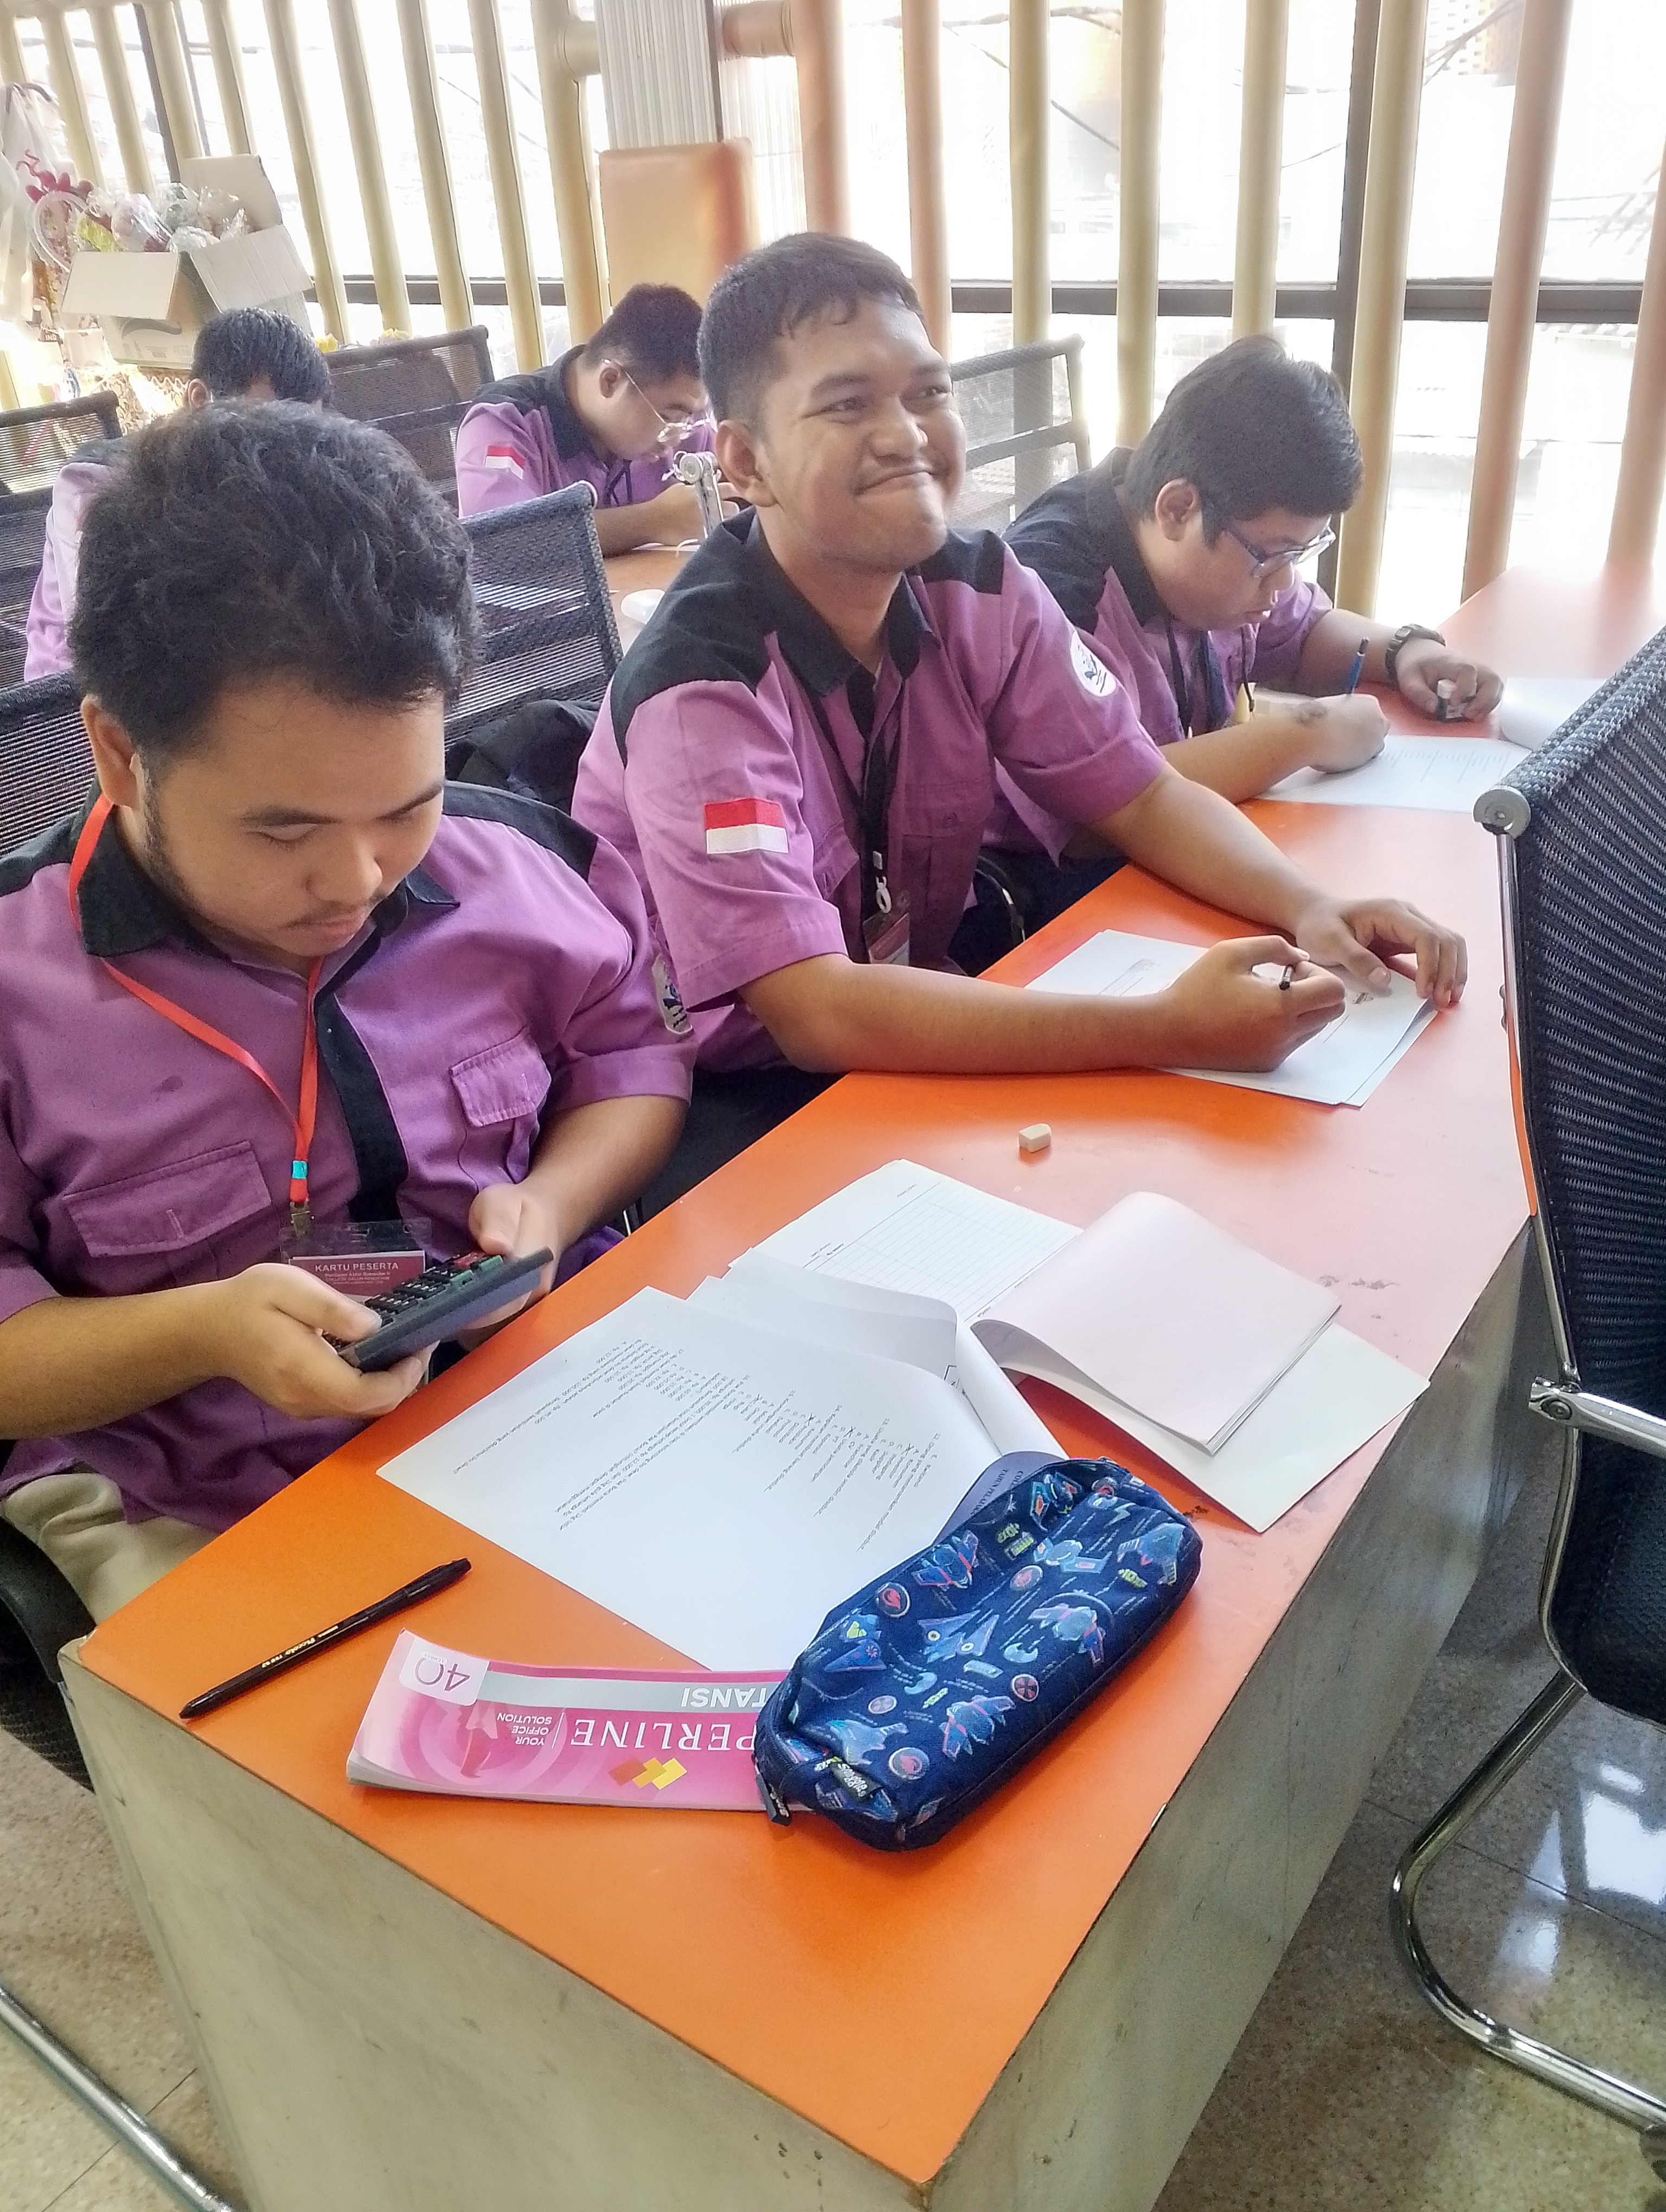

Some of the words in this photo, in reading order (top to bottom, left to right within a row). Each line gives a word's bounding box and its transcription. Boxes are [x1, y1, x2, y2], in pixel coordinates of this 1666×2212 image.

[315, 1264, 350, 1272] KARTU
[353, 1262, 399, 1270] PESERTA
[992, 1468, 1009, 1487] TAHUN
[415, 1657, 471, 1692] 40
[681, 1687, 767, 1708] TANSI
[496, 1712, 553, 1725] SOLUTION
[511, 1725, 550, 1736] OFFICE
[570, 1719, 755, 1751] PERLINE
[515, 1735, 545, 1746] YOUR
